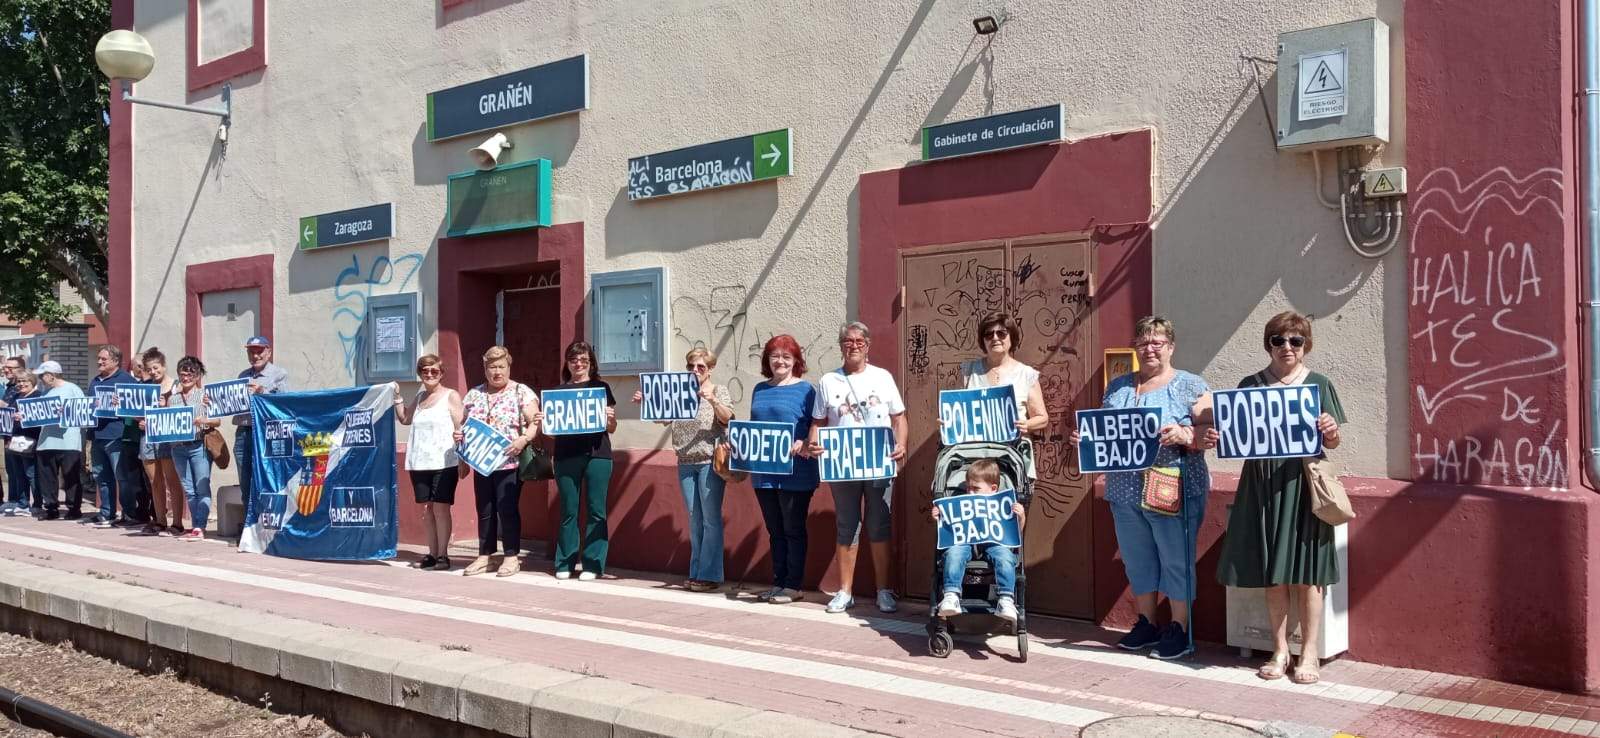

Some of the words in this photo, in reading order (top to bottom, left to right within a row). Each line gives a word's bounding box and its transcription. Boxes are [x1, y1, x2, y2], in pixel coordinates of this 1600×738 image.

[479, 82, 533, 115] GRAÑÉN
[1310, 99, 1338, 108] RIESGO
[934, 133, 978, 148] Gabinete
[981, 128, 994, 139] de
[997, 117, 1054, 136] Circulación
[655, 159, 723, 183] Barcelona
[334, 217, 373, 236] Zaragoza
[117, 387, 159, 411] FRULA
[643, 372, 698, 419] ROBRES
[20, 400, 61, 421] BARBUES
[64, 398, 95, 427] CURBE
[147, 411, 193, 437] TRAMACED
[1217, 387, 1318, 457] ROBRES
[1079, 412, 1159, 442] ALBERO
[730, 426, 792, 464] SODETO
[820, 428, 894, 479] FRAELLA
[1095, 440, 1147, 468] BAJO
[331, 507, 374, 524] BARCELONA
[938, 496, 1014, 528] ALBERO
[952, 519, 1004, 545] BAJO
